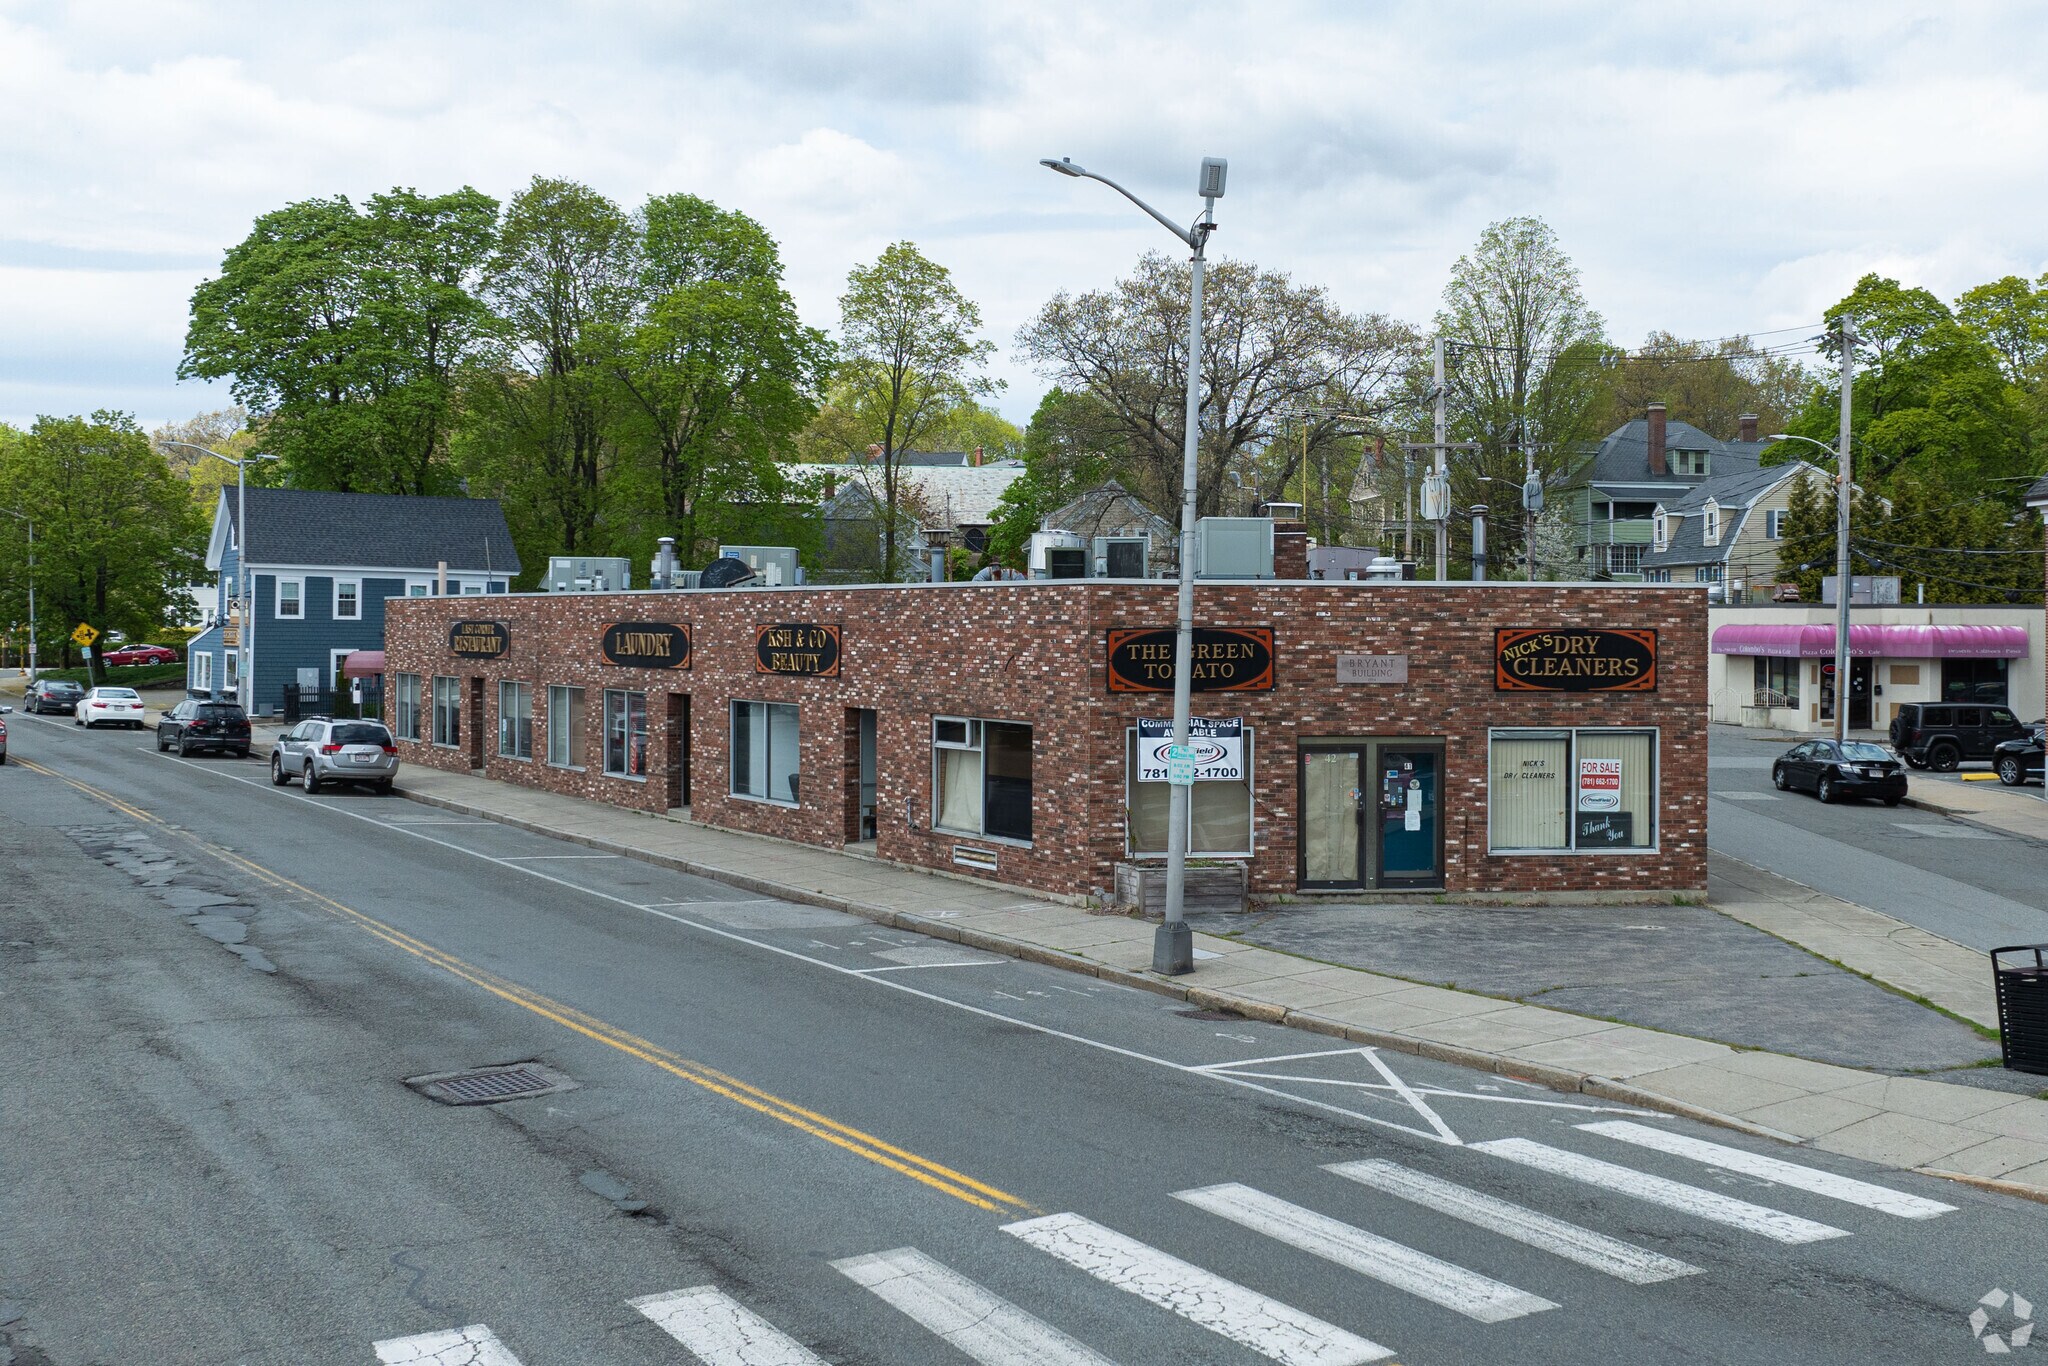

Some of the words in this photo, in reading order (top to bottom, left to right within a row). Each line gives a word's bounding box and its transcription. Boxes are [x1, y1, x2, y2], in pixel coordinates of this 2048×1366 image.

[454, 635, 502, 653] RESTAURANT
[615, 632, 673, 656] LAUNDRY
[767, 629, 793, 648] KSH
[796, 629, 805, 648] &
[809, 629, 827, 649] CO
[1126, 644, 1171, 660] THE
[1503, 634, 1553, 661] NICK'S
[1553, 635, 1601, 654] DRY
[771, 652, 821, 672] BEAUTY
[1349, 658, 1396, 668] BRYANT
[1513, 657, 1639, 676] CLEANERS
[1144, 662, 1235, 679] TOATO
[1352, 669, 1393, 678] BUILDING
[1141, 718, 1206, 728] COMMIAL
[1208, 718, 1239, 728] SPACE
[1171, 747, 1178, 757] 2
[1325, 754, 1337, 763] 42
[1582, 762, 1598, 773] FOR
[1600, 762, 1620, 773] SALE
[1582, 778, 1595, 786] (781)
[1582, 816, 1611, 836] Thank
[1606, 829, 1624, 841] You
